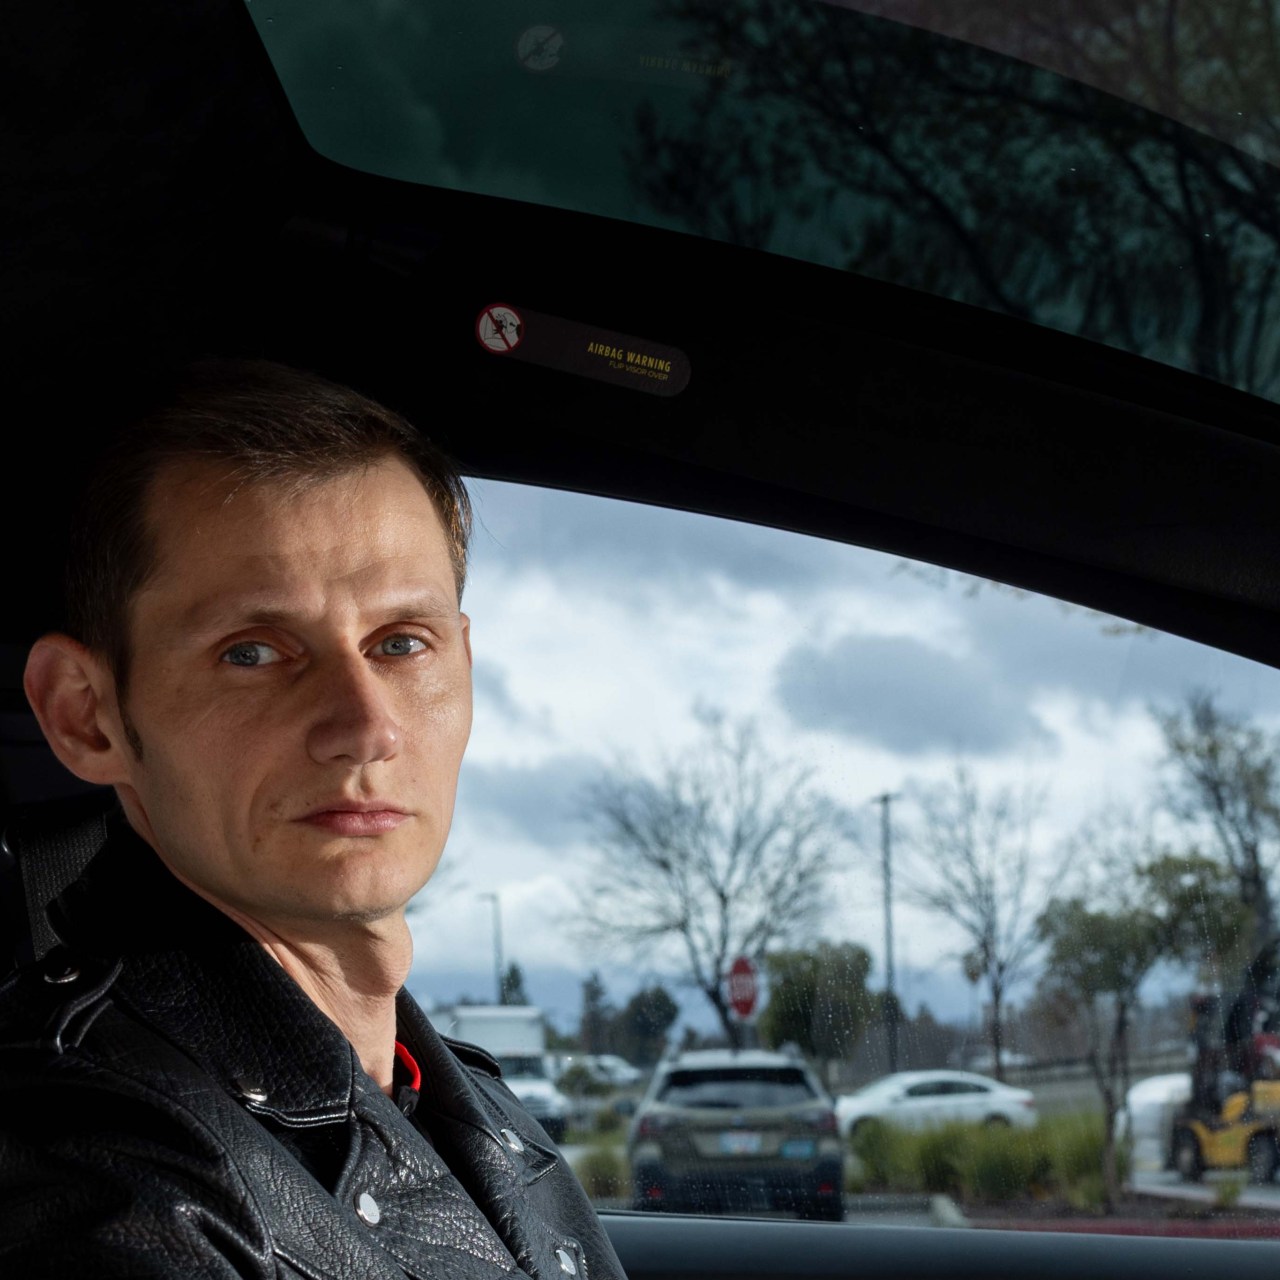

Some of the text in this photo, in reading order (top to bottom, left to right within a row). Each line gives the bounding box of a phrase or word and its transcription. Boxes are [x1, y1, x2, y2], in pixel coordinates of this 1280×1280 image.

[587, 342, 671, 372] AIRBAG WARNING
[625, 364, 647, 375] VISOR
[648, 369, 668, 381] OVER
